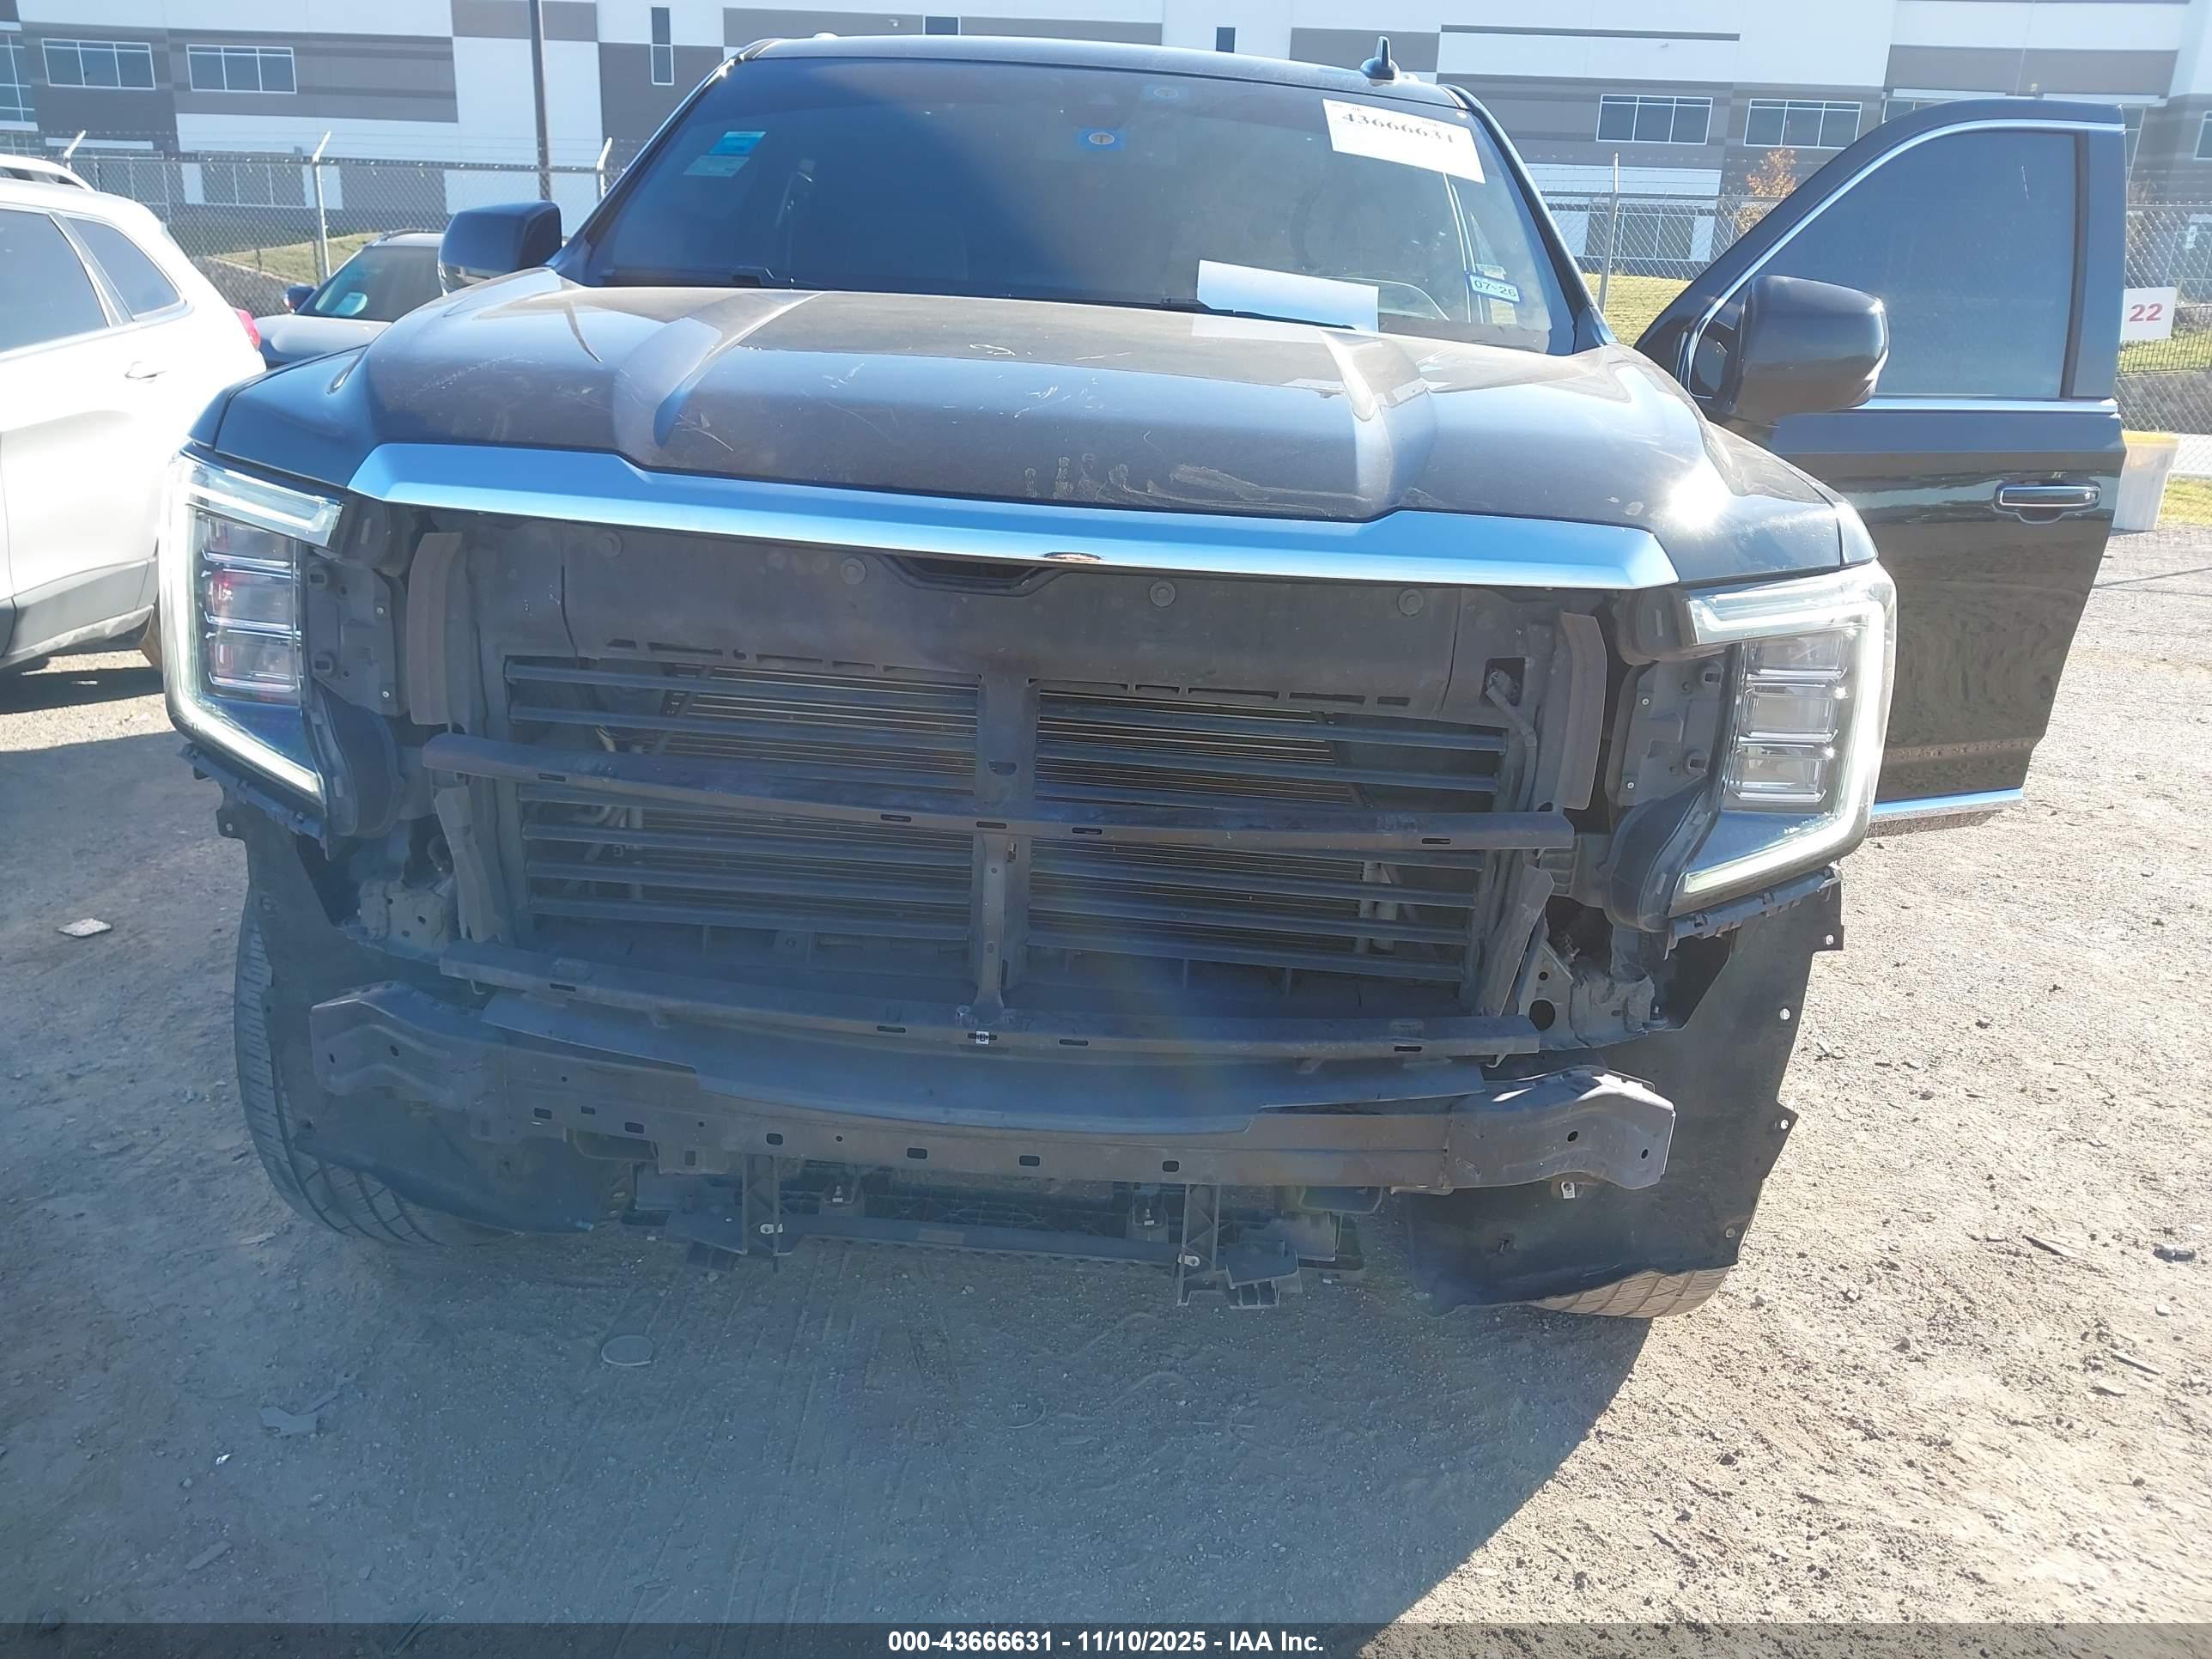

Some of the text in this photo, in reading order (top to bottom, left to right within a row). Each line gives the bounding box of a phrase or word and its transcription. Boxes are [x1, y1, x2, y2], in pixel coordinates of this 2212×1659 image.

[1341, 112, 1455, 143] 43666631
[1474, 280, 1517, 297] 07-26
[2129, 303, 2163, 322] 22
